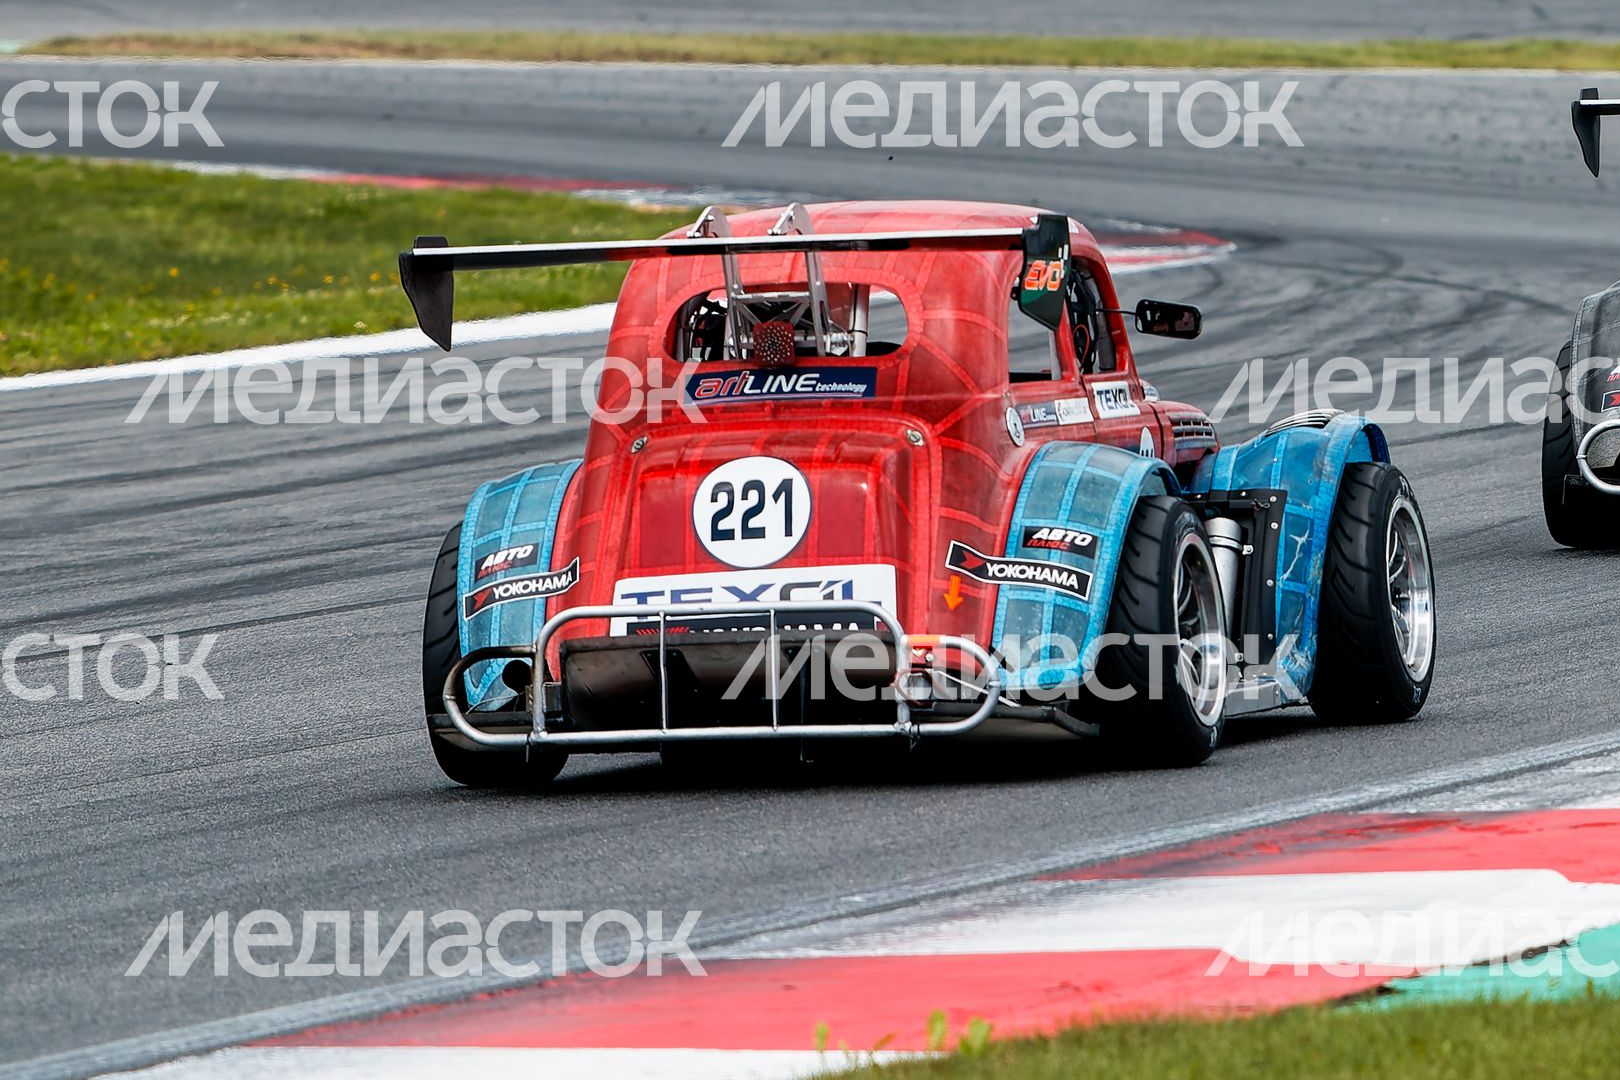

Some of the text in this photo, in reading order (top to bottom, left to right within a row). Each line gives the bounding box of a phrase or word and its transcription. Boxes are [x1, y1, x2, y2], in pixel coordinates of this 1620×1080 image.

[815, 381, 867, 393] technology
[710, 478, 794, 542] 221
[1032, 528, 1092, 547] АВТО
[480, 545, 534, 571] АВТО
[492, 570, 573, 600] YOKOHAMA
[986, 562, 1079, 590] YOKOHAMA
